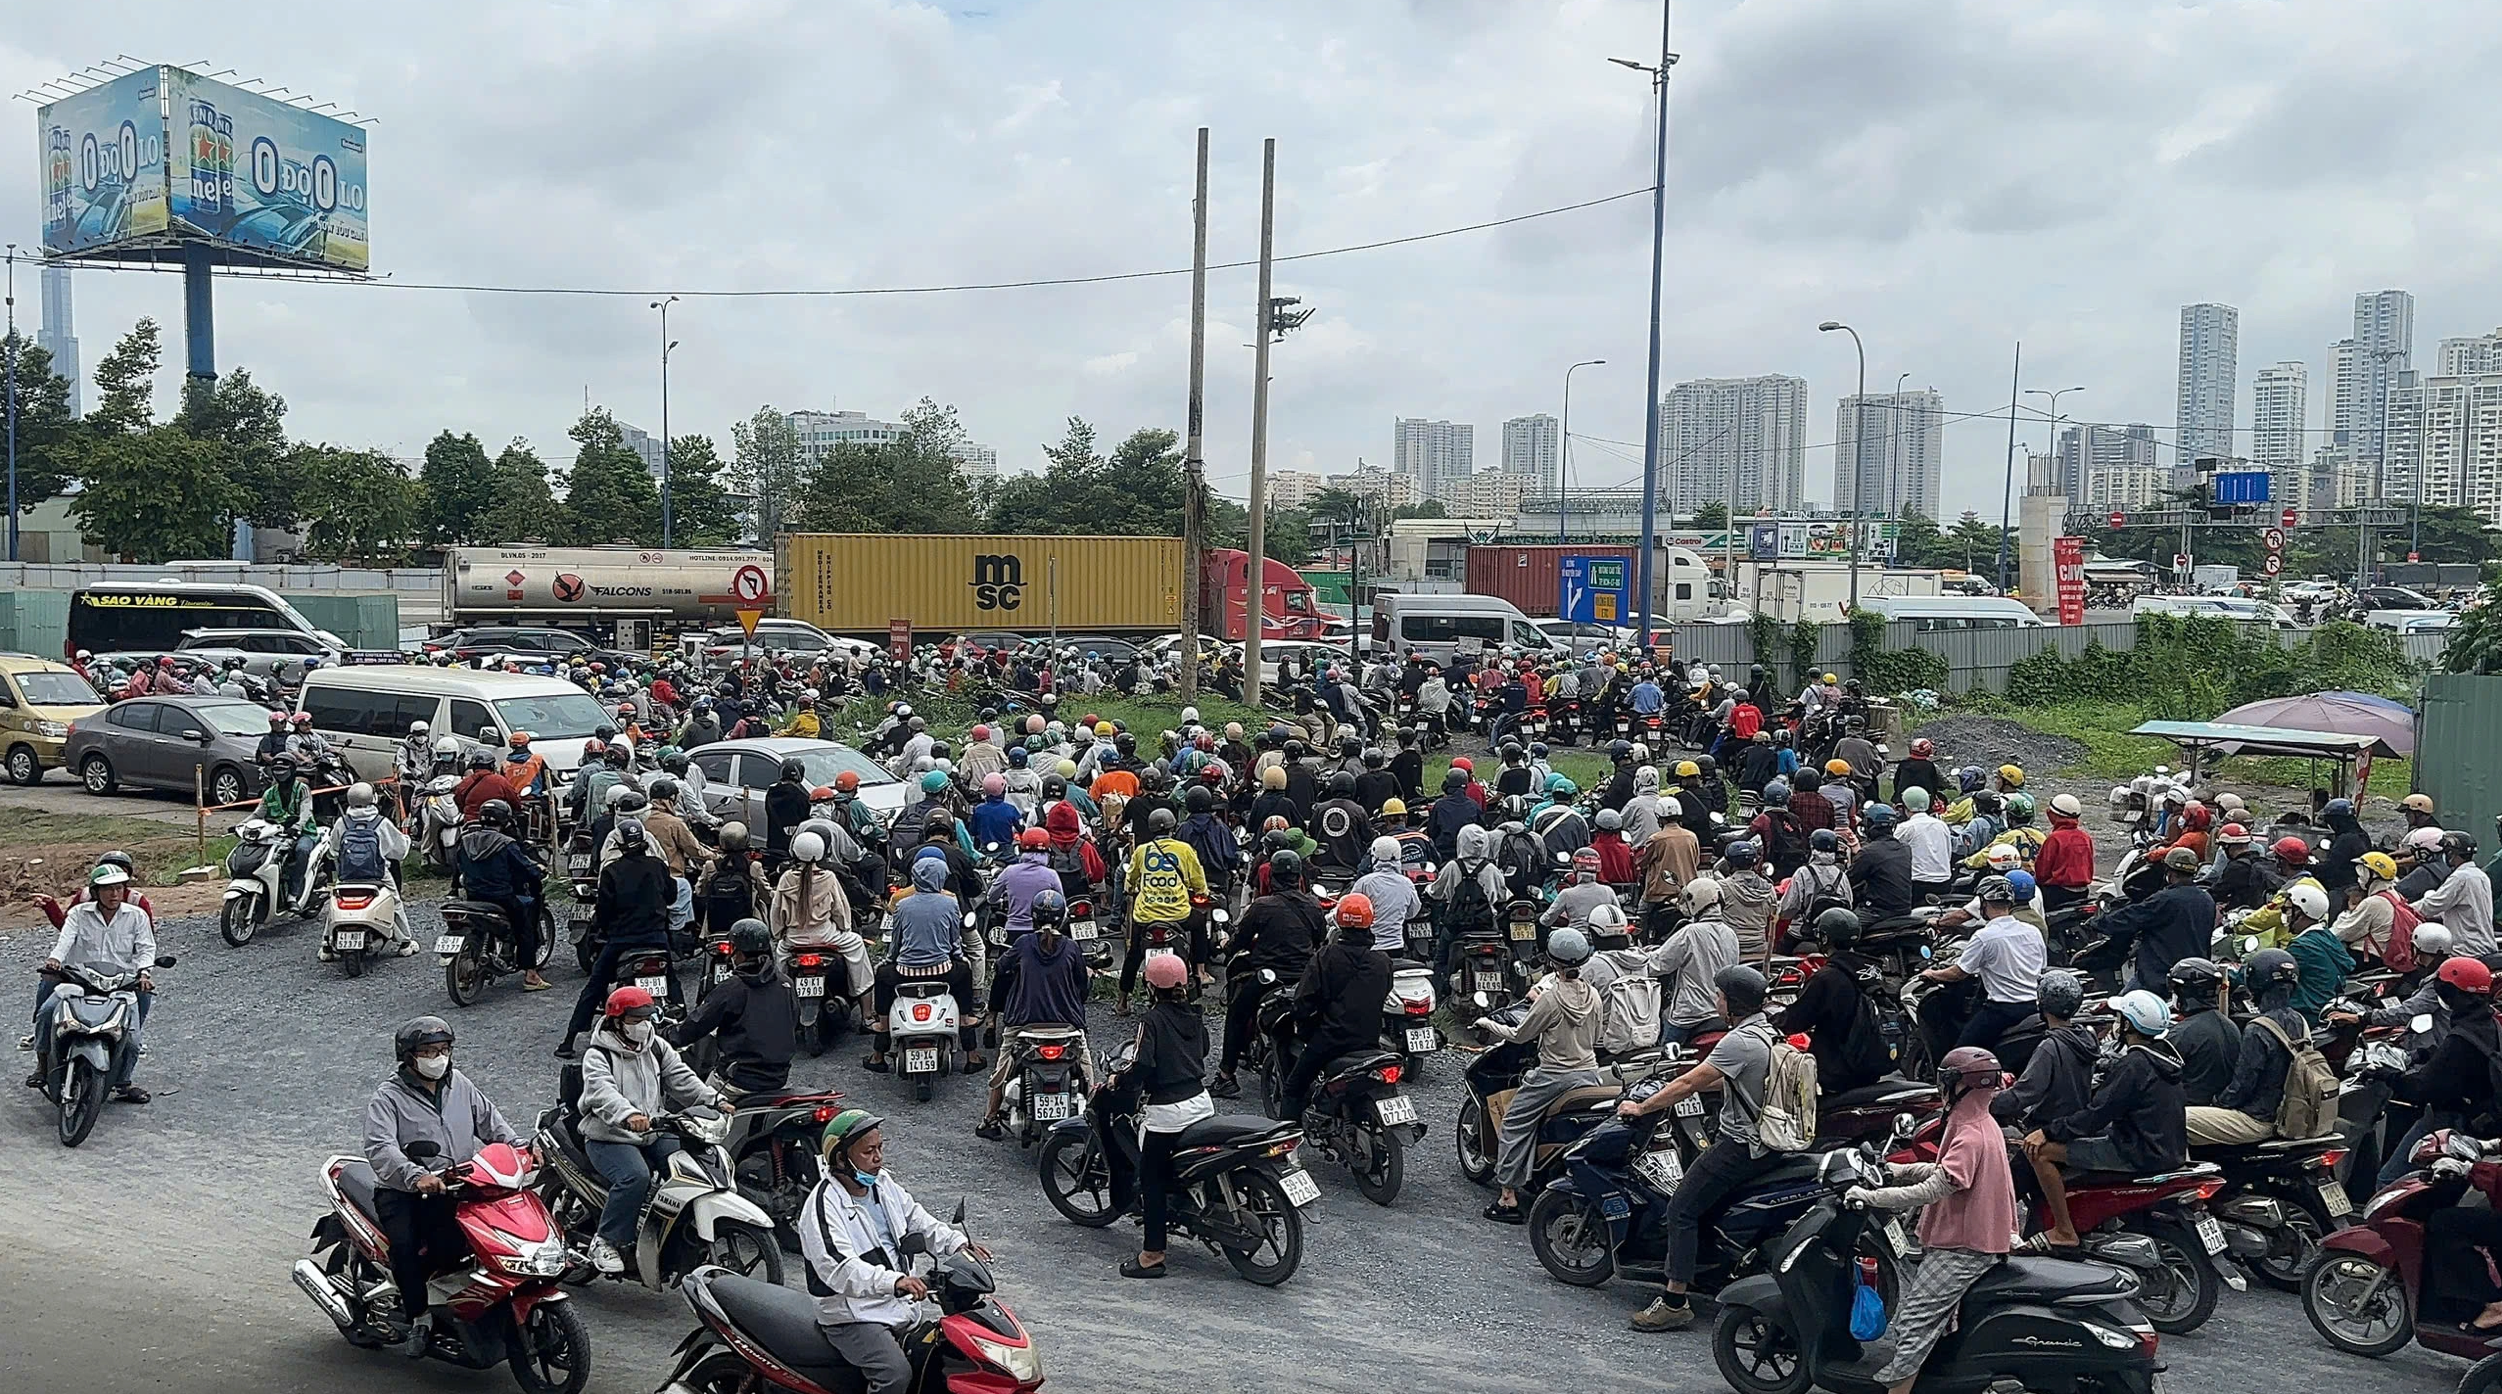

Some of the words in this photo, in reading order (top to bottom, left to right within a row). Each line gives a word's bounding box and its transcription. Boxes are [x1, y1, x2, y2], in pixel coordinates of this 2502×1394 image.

[138, 134, 159, 169] LO
[339, 180, 364, 211] LO
[1675, 537, 1702, 546] Castrol
[592, 586, 652, 597] FALCONS
[100, 596, 132, 605] SAO
[135, 594, 178, 606] VÀNG
[1144, 845, 1179, 872] be
[1143, 873, 1178, 888] Food
[911, 1050, 934, 1060] 59-X4
[909, 1060, 936, 1071] 141.59
[1040, 1096, 1064, 1107] 59-X4
[1037, 1106, 1067, 1118] 562.97
[657, 1193, 681, 1208] YAMAHA
[2014, 1336, 2083, 1347] Grande
